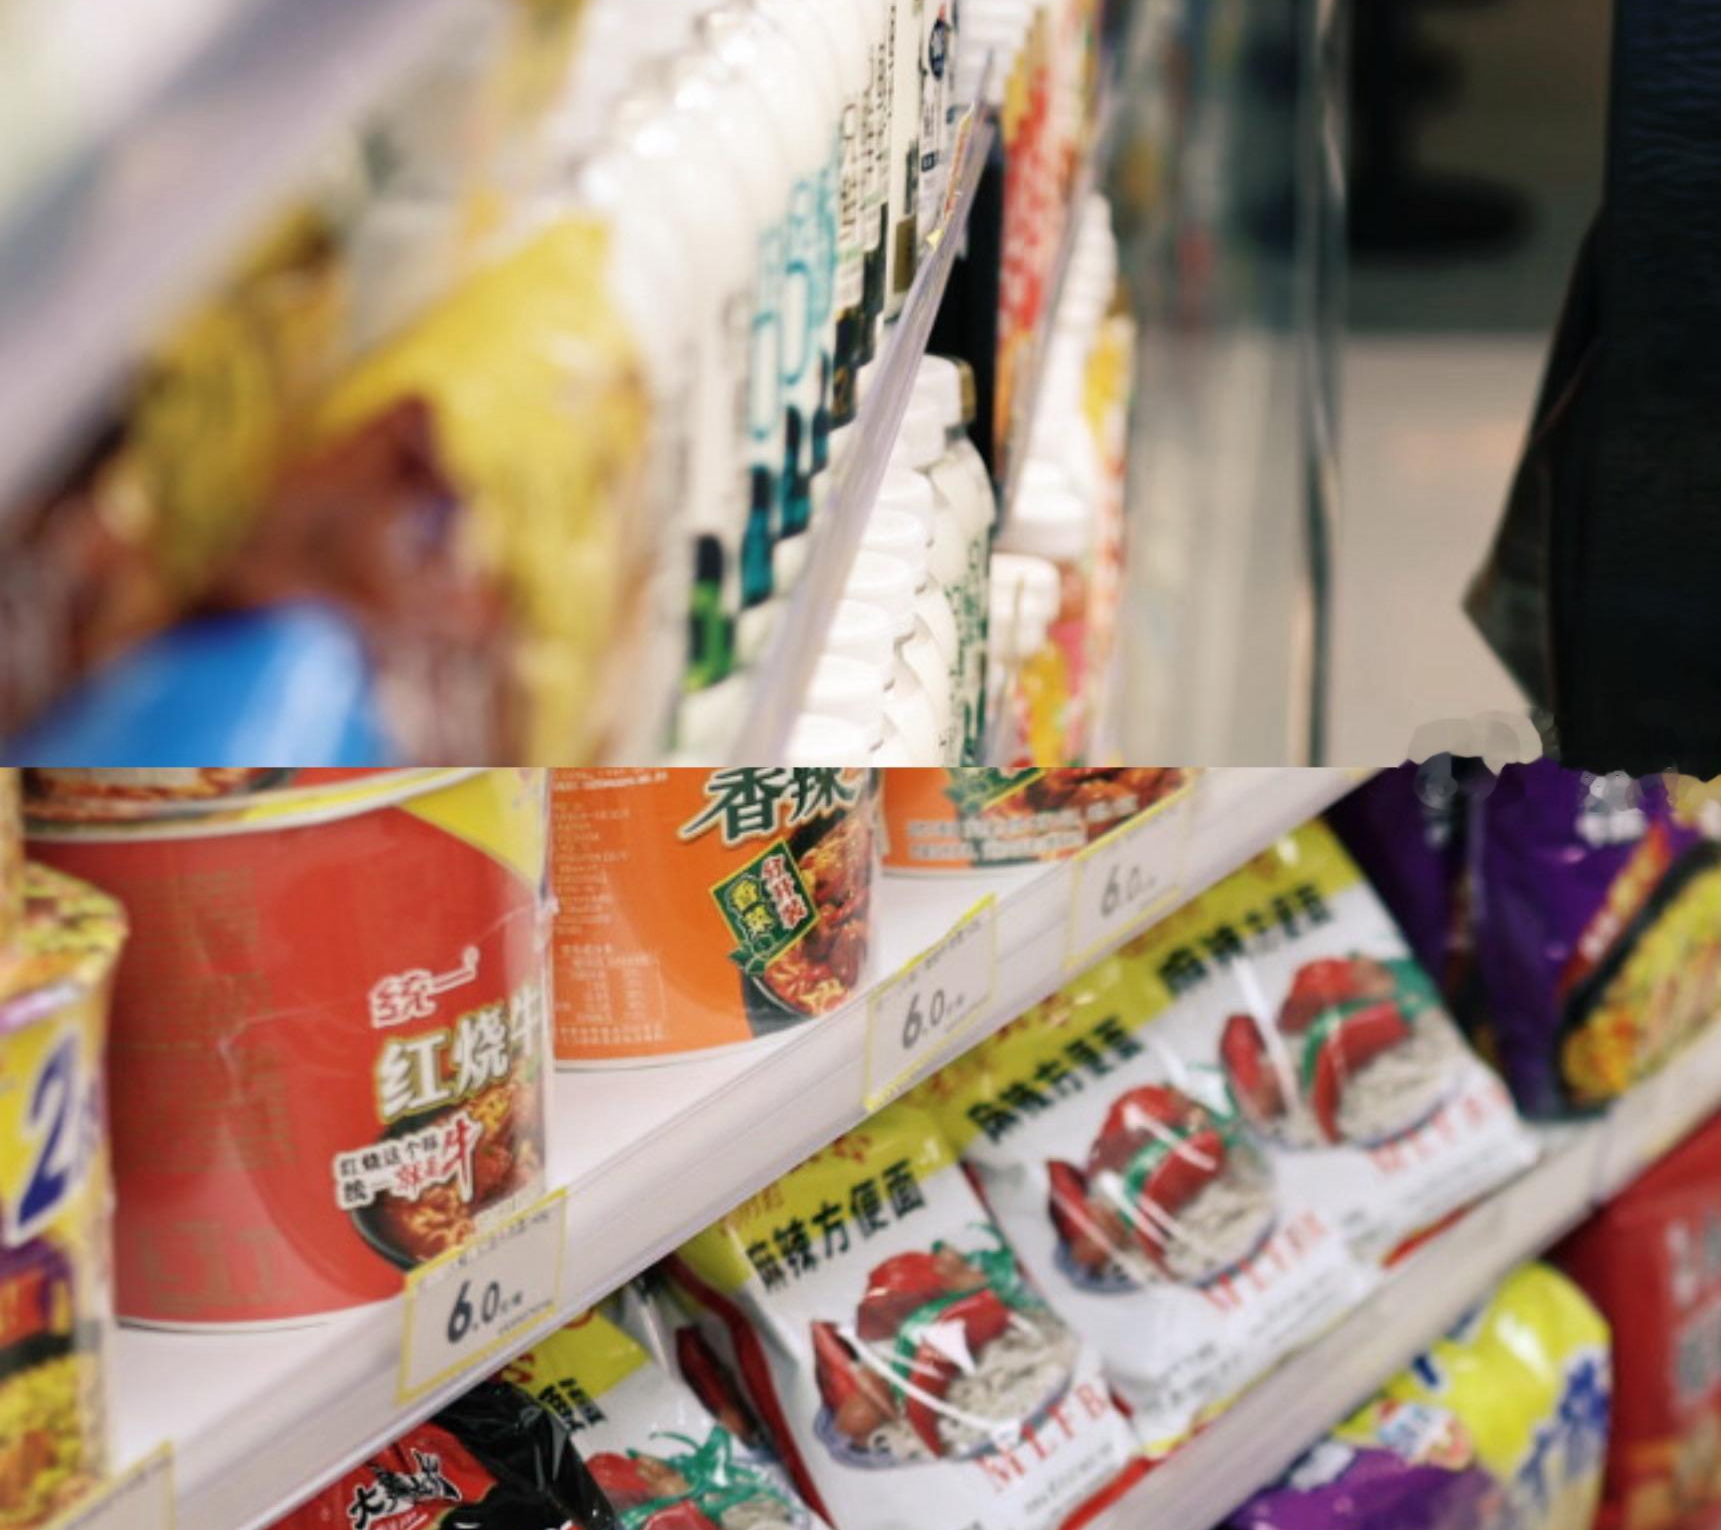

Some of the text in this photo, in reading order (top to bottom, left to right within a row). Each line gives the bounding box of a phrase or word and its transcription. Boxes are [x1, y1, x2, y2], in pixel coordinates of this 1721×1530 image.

[901, 987, 946, 1050] 6.0
[745, 1158, 927, 1293] 麻辣方便面
[446, 1279, 501, 1344] 6.0
